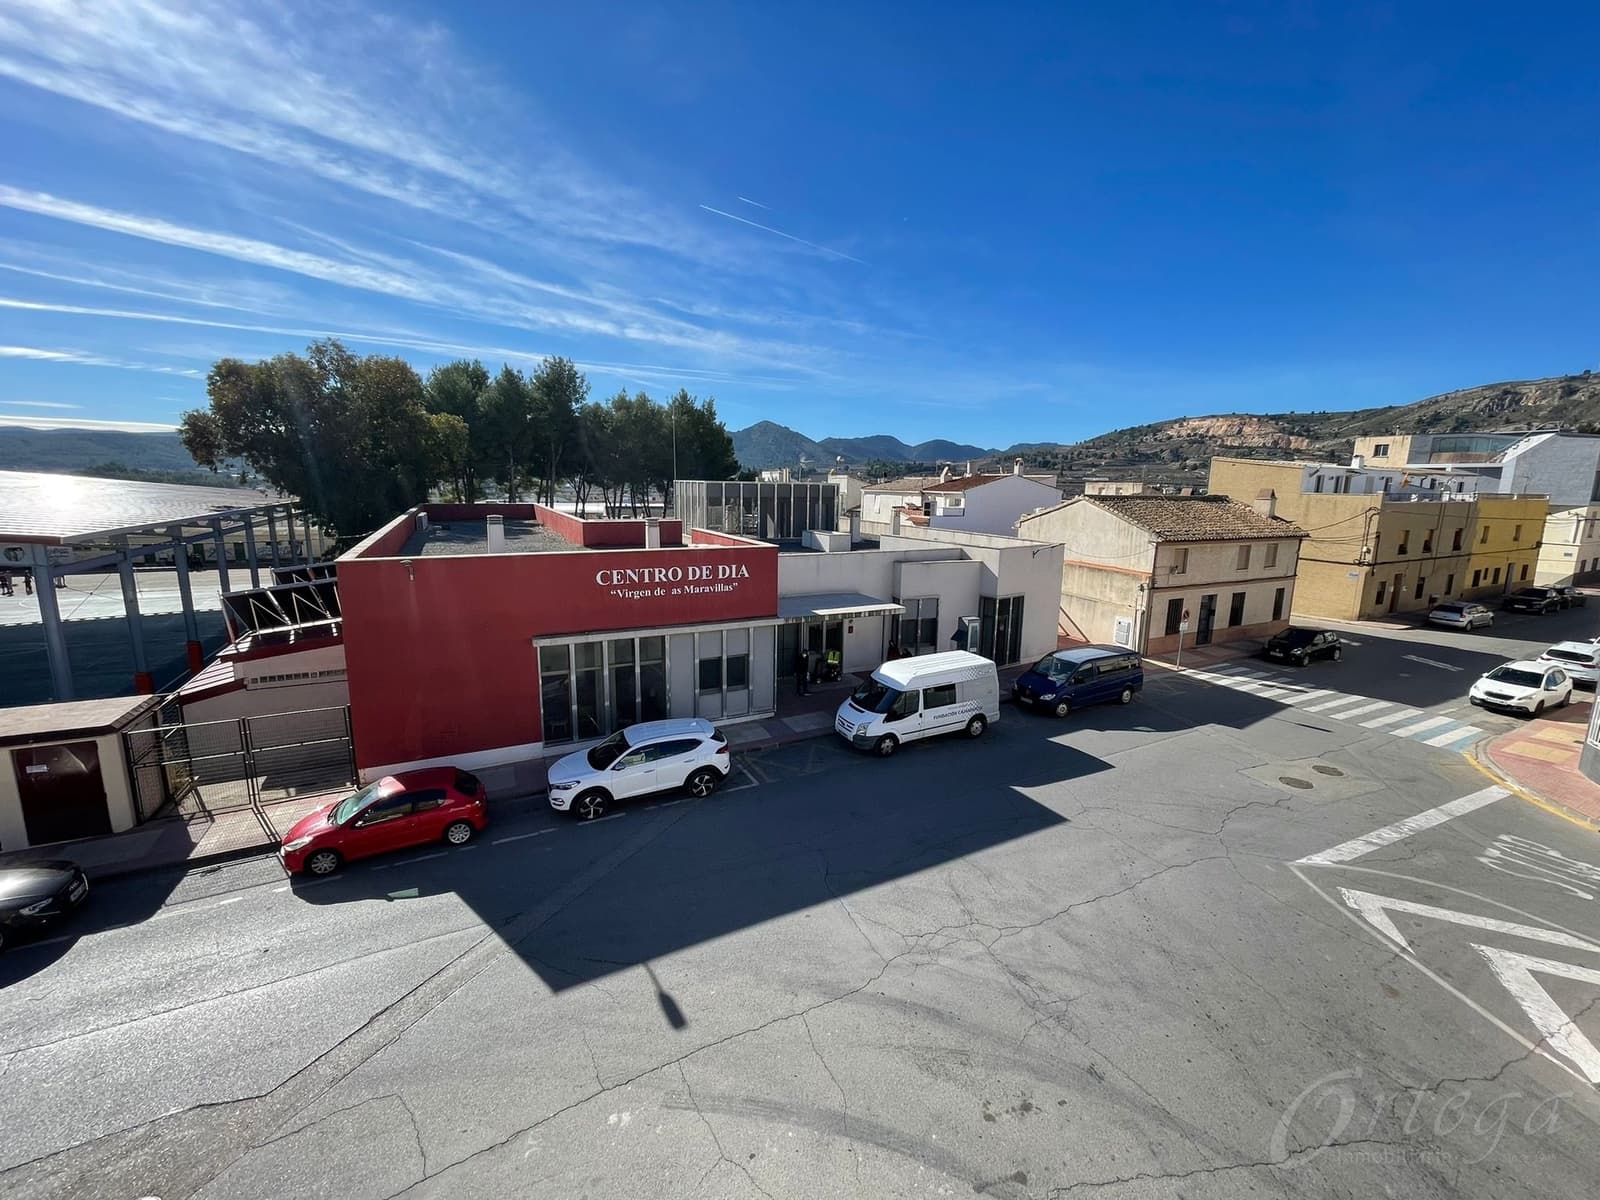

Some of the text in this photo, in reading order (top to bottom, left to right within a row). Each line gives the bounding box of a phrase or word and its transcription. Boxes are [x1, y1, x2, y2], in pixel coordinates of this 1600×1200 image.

[595, 564, 750, 586] CENTRO DE DIA
[654, 587, 666, 597] de
